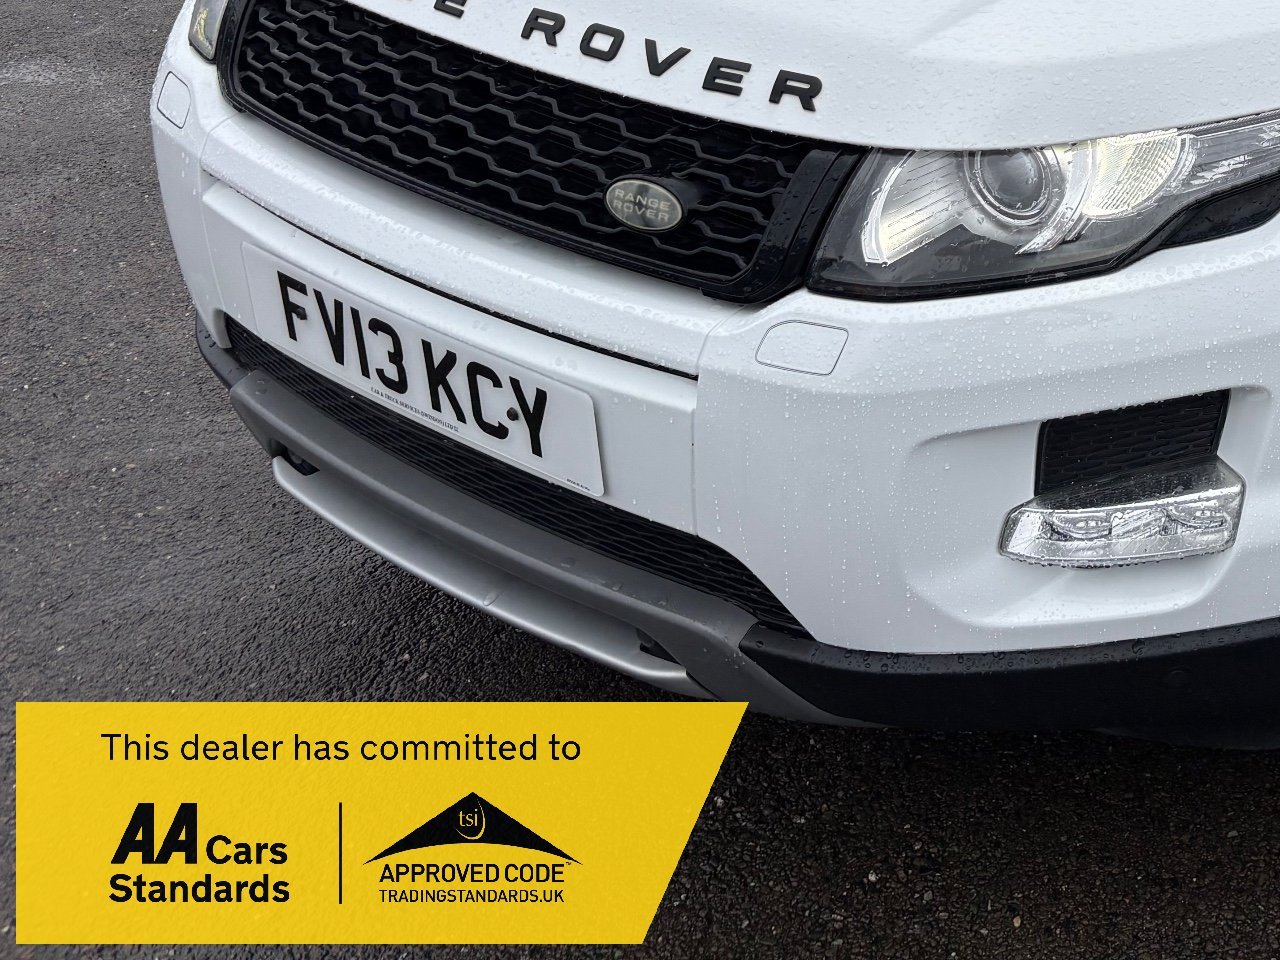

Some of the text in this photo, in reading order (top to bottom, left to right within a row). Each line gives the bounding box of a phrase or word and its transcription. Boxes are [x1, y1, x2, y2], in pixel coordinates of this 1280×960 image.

[520, 7, 823, 112] ROVER
[612, 200, 670, 223] ROVER
[614, 188, 672, 211] RANGE
[277, 270, 548, 458] FV13 KCY
